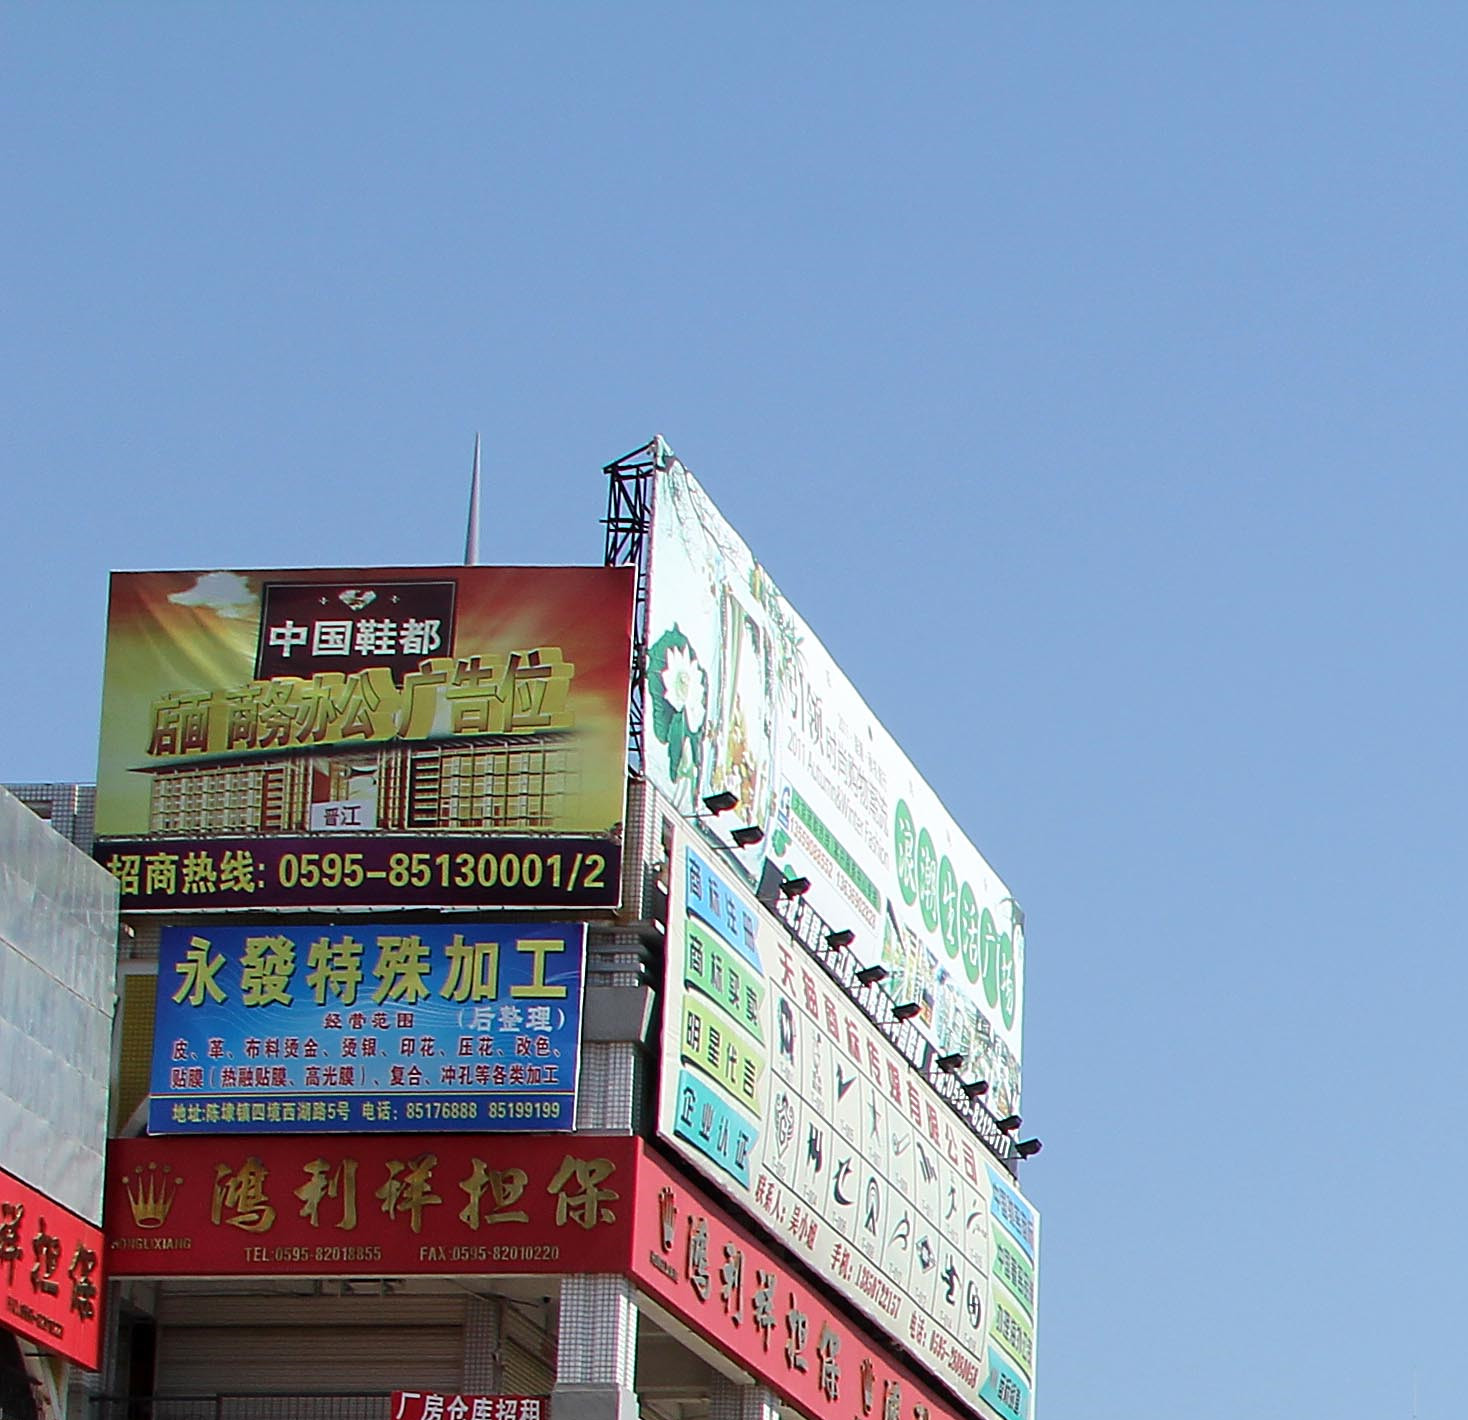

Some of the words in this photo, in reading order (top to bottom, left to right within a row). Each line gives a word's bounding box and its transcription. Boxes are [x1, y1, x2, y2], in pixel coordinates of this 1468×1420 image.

[269, 619, 441, 658] 中国鞋都
[146, 690, 213, 755] 店面
[225, 668, 384, 751] 商务办公
[398, 652, 562, 741] 广告位
[322, 804, 361, 826] 晋江
[108, 851, 266, 896] 招商热线:
[278, 852, 606, 892] 0595-85130001/2
[172, 933, 570, 1008] 永發特殊加工
[324, 1012, 415, 1030] 经营范围
[361, 1101, 478, 1121] 电话:85176888
[487, 1102, 561, 1120] 85199199
[208, 1151, 621, 1234] 鸿利祥担保
[244, 1246, 382, 1262] TEL:0595-82018855
[419, 1246, 560, 1262] FAX:0595-82010220
